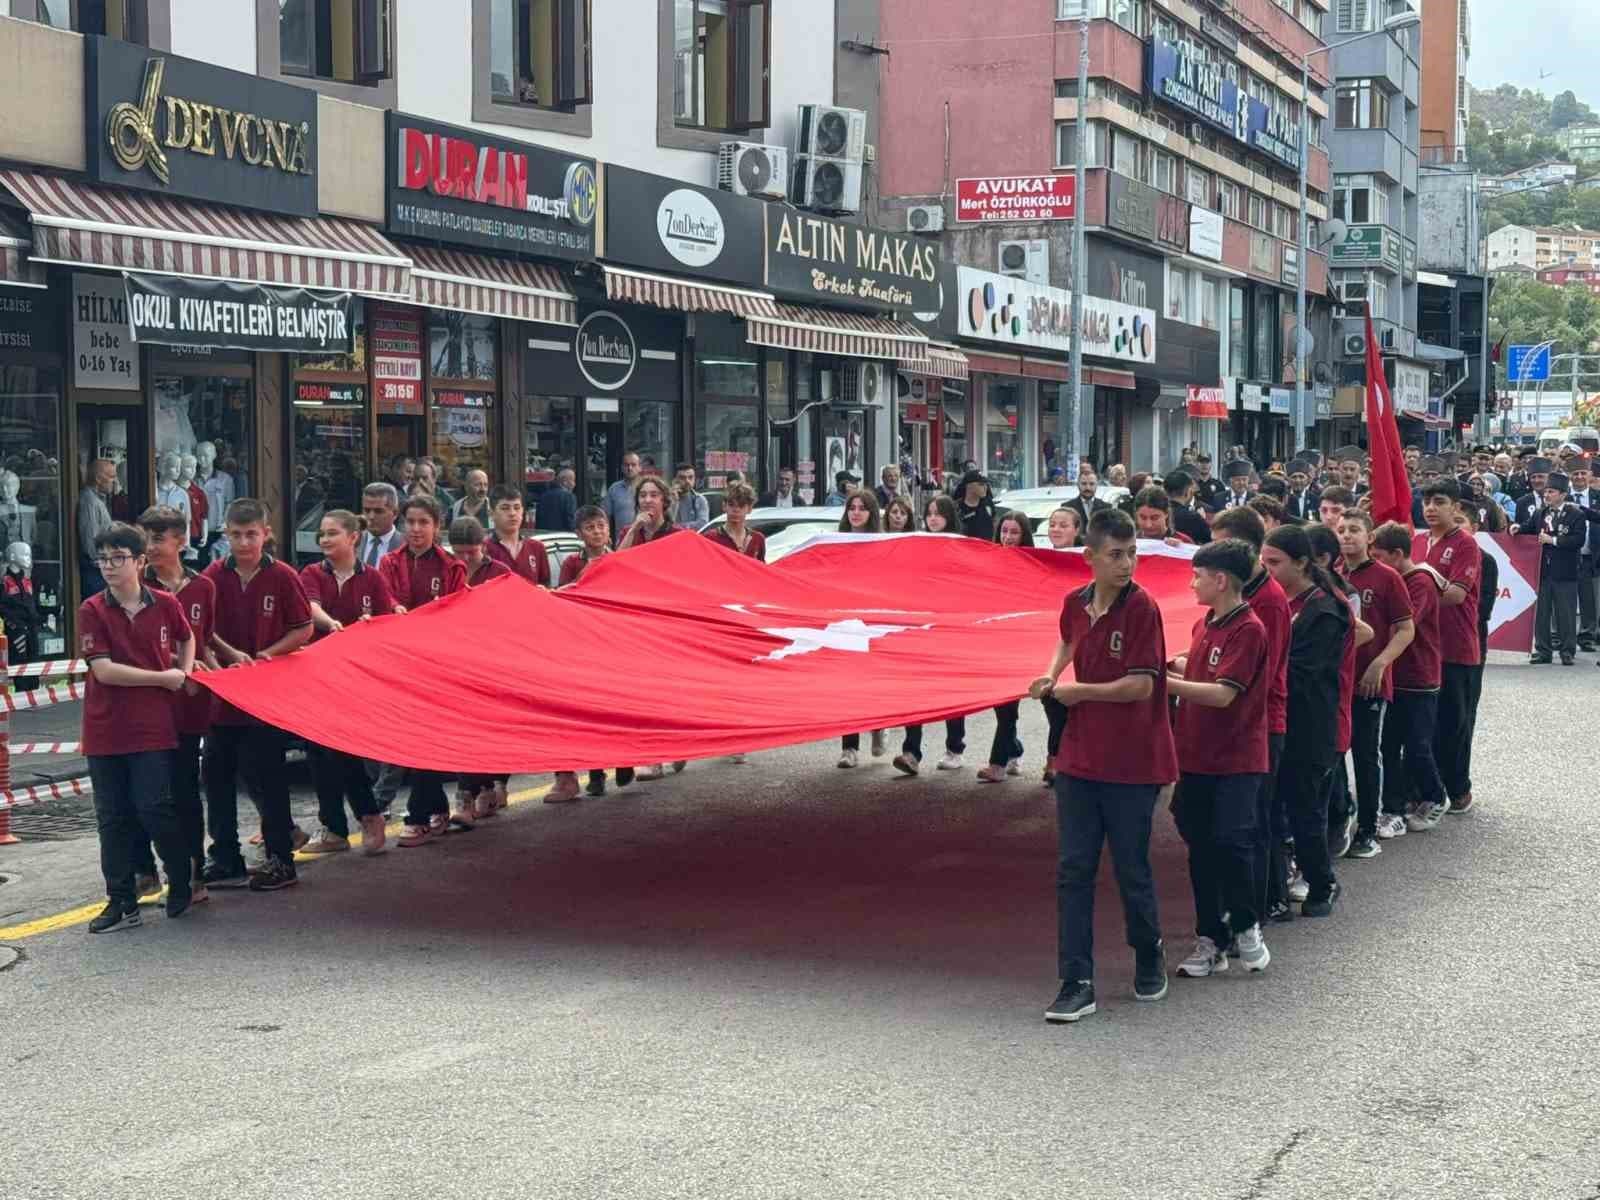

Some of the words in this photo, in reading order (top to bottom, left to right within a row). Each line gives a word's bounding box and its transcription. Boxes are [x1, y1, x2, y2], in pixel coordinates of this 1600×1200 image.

[164, 96, 312, 175] DEVONA
[398, 127, 528, 211] DURAN
[976, 178, 1057, 194] AVUKAT
[961, 199, 987, 210] Mert
[990, 194, 1072, 209] ÖZTÜRKOĞLU
[1023, 209, 1036, 218] 03
[776, 212, 845, 265] ALTIN
[856, 229, 936, 282] MAKAS
[811, 268, 856, 295] Erkek
[858, 277, 913, 305] Kuaförü
[132, 293, 175, 329] OKUL
[179, 297, 273, 336] KIYAFETLERİ
[277, 302, 348, 346] GELMİŞTİR
[90, 330, 120, 349] bebe
[79, 354, 105, 372] 0-16
[109, 355, 132, 378] Yaş
